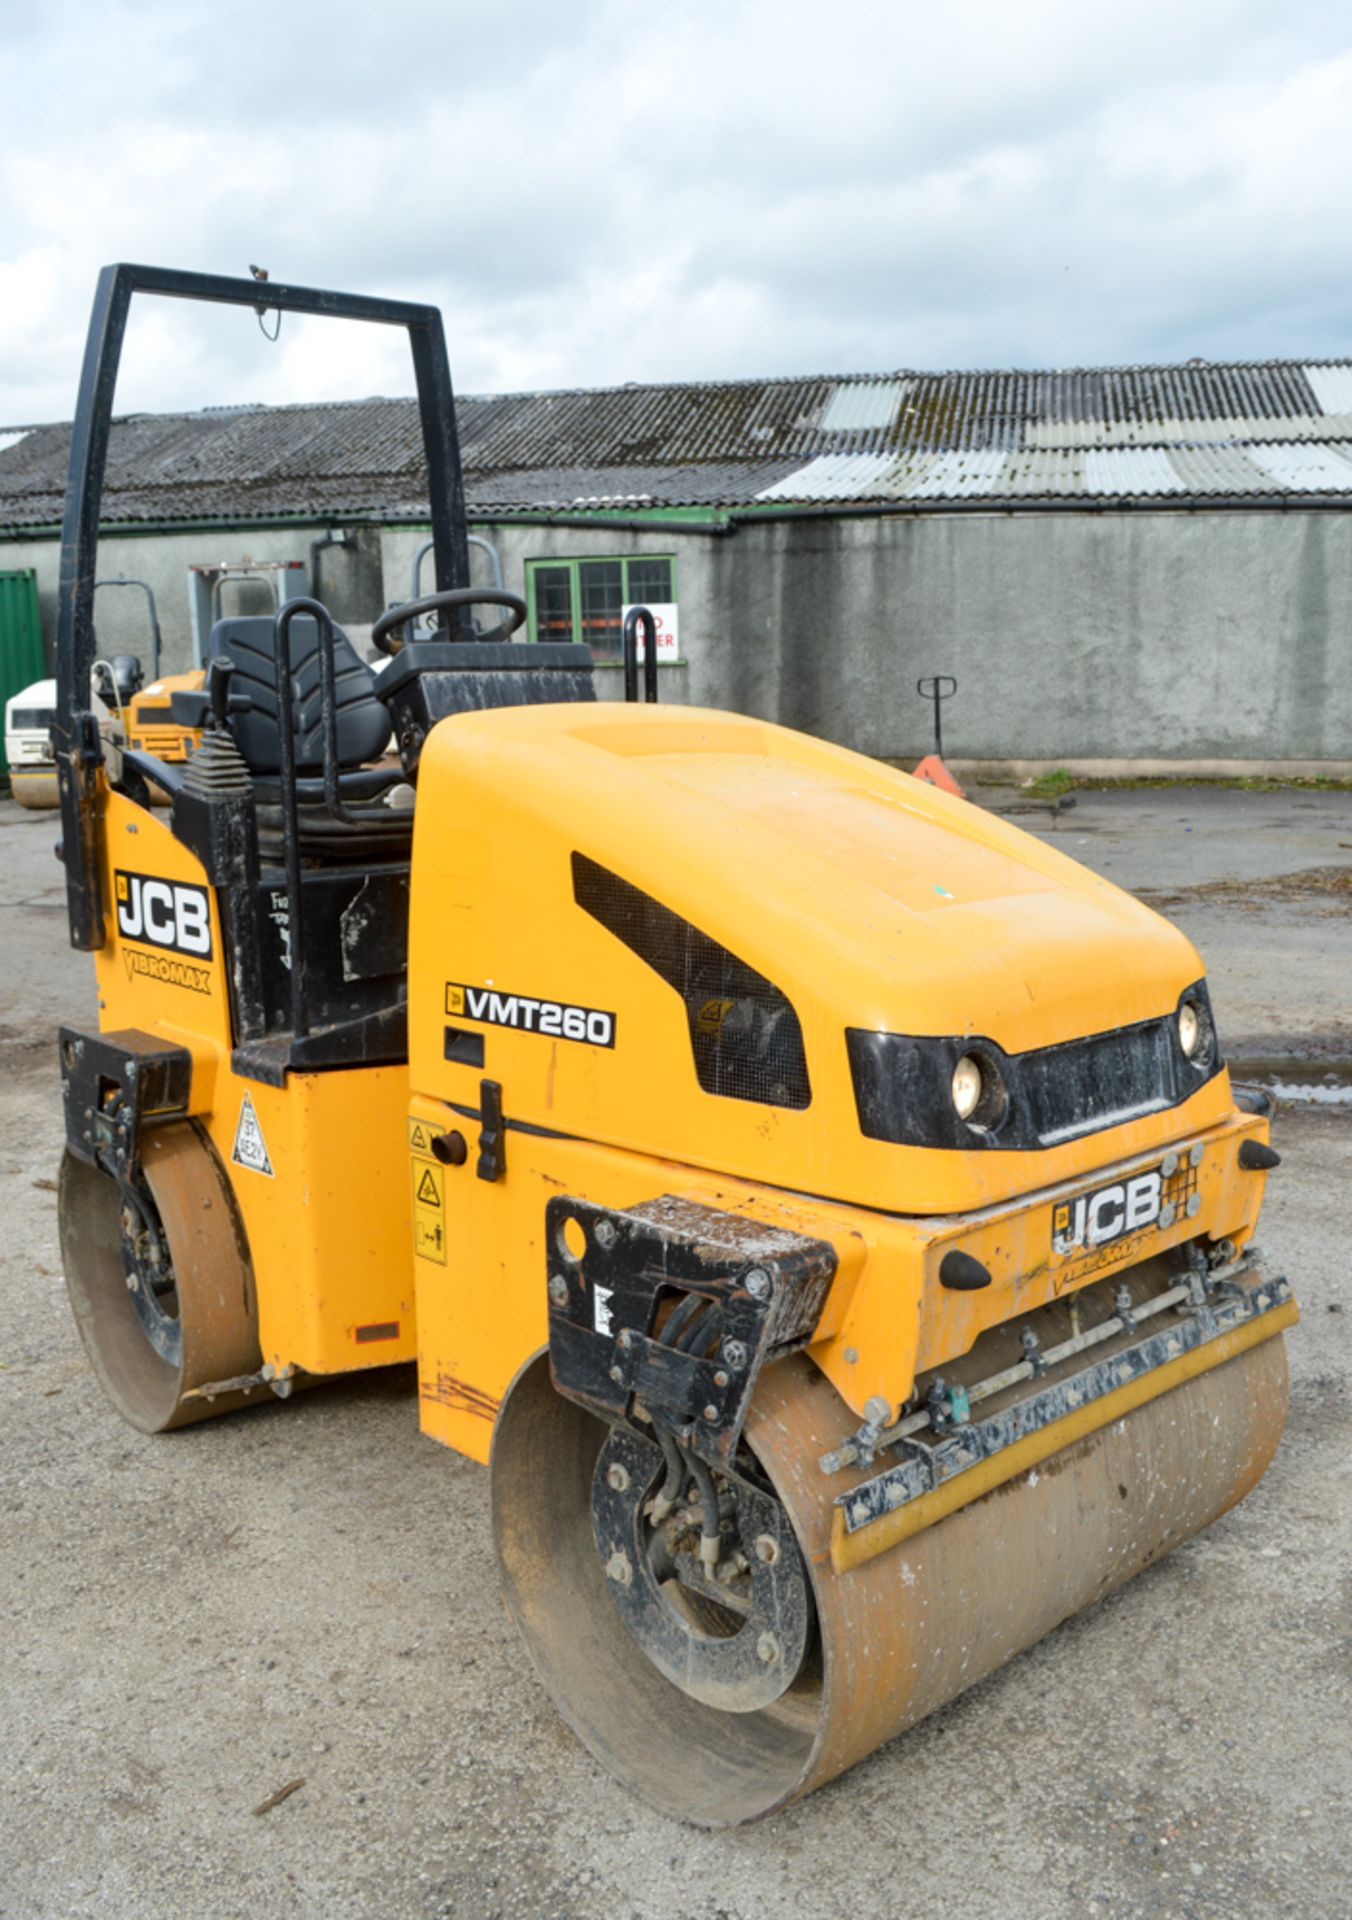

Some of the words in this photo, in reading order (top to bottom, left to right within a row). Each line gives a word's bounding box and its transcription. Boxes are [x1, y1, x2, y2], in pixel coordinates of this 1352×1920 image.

[118, 878, 211, 954] JCB
[121, 946, 212, 996] VIBROMAX
[465, 988, 612, 1045] VMT260
[1052, 1172, 1162, 1257] JCB
